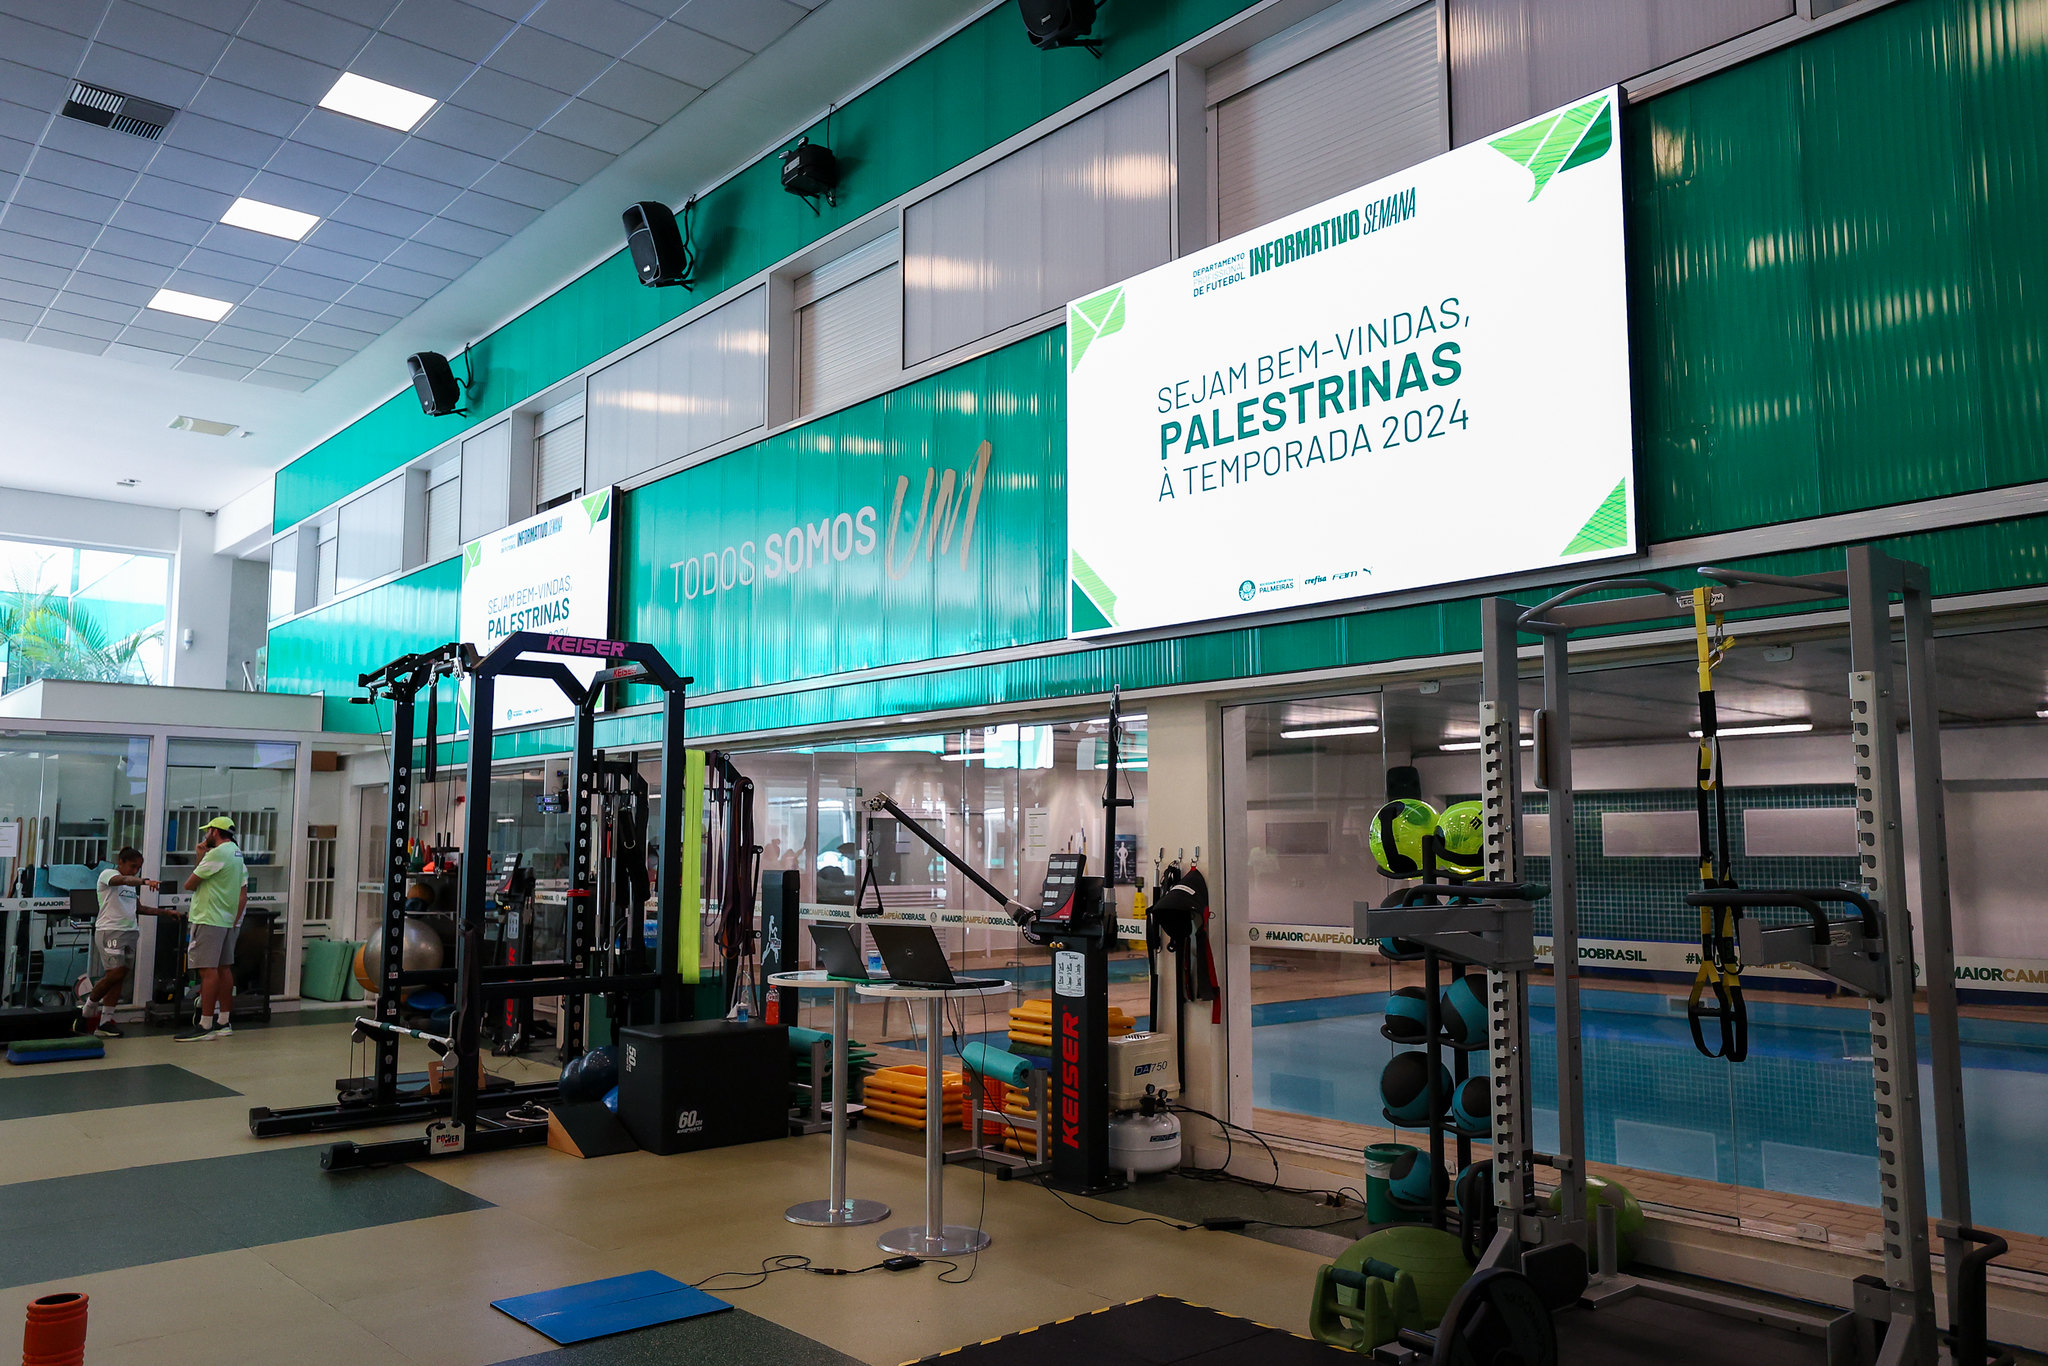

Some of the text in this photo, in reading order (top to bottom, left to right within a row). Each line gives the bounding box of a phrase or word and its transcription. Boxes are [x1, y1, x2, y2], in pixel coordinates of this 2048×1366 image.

[1193, 252, 1246, 278] DEPARTAMENTO
[1249, 186, 1416, 278] INFORMATIVO SEMANA
[1193, 271, 1246, 298] DE FUTEBOL
[1158, 296, 1470, 414] SEJAM BEM-VINDAS,
[1160, 340, 1462, 461] PALESTRINAS
[1158, 397, 1470, 503] À TEMPORADA 2024
[670, 541, 756, 603] TODOS
[765, 506, 877, 579] SOMOS
[1259, 582, 1294, 594] PALMEIRAS
[488, 593, 515, 615] SEJAM
[488, 597, 570, 640] PALESTRINAS
[546, 635, 625, 657] KEISER
[1062, 1012, 1079, 1149] KEISER
